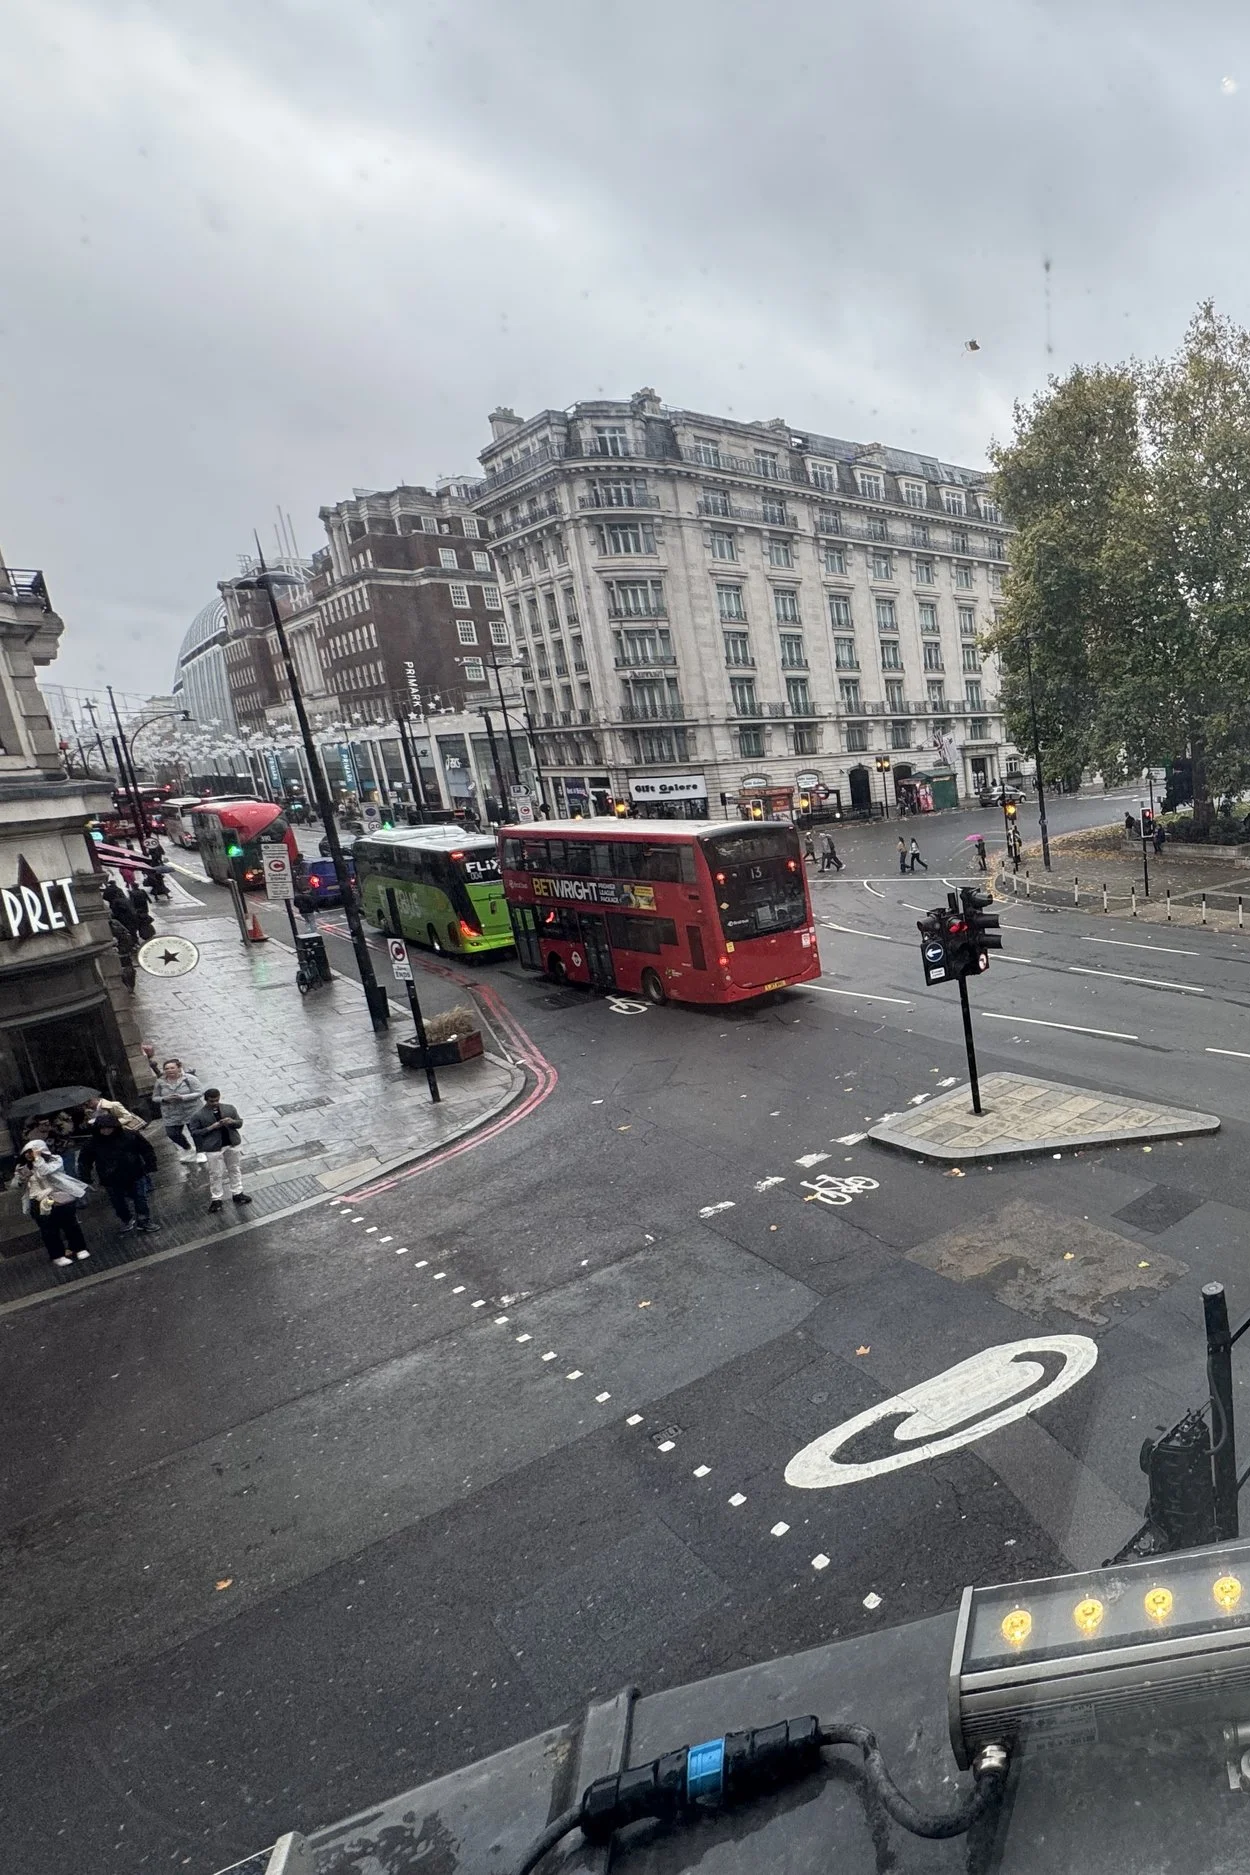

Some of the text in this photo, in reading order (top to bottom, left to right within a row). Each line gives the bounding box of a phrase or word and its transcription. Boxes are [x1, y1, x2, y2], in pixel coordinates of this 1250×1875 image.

[341, 754, 353, 783] PRIMARK
[634, 784, 698, 793] Gift Galore
[751, 866, 762, 879] 13
[532, 877, 598, 902] BETWRIGHT
[1, 877, 80, 937] PRET
